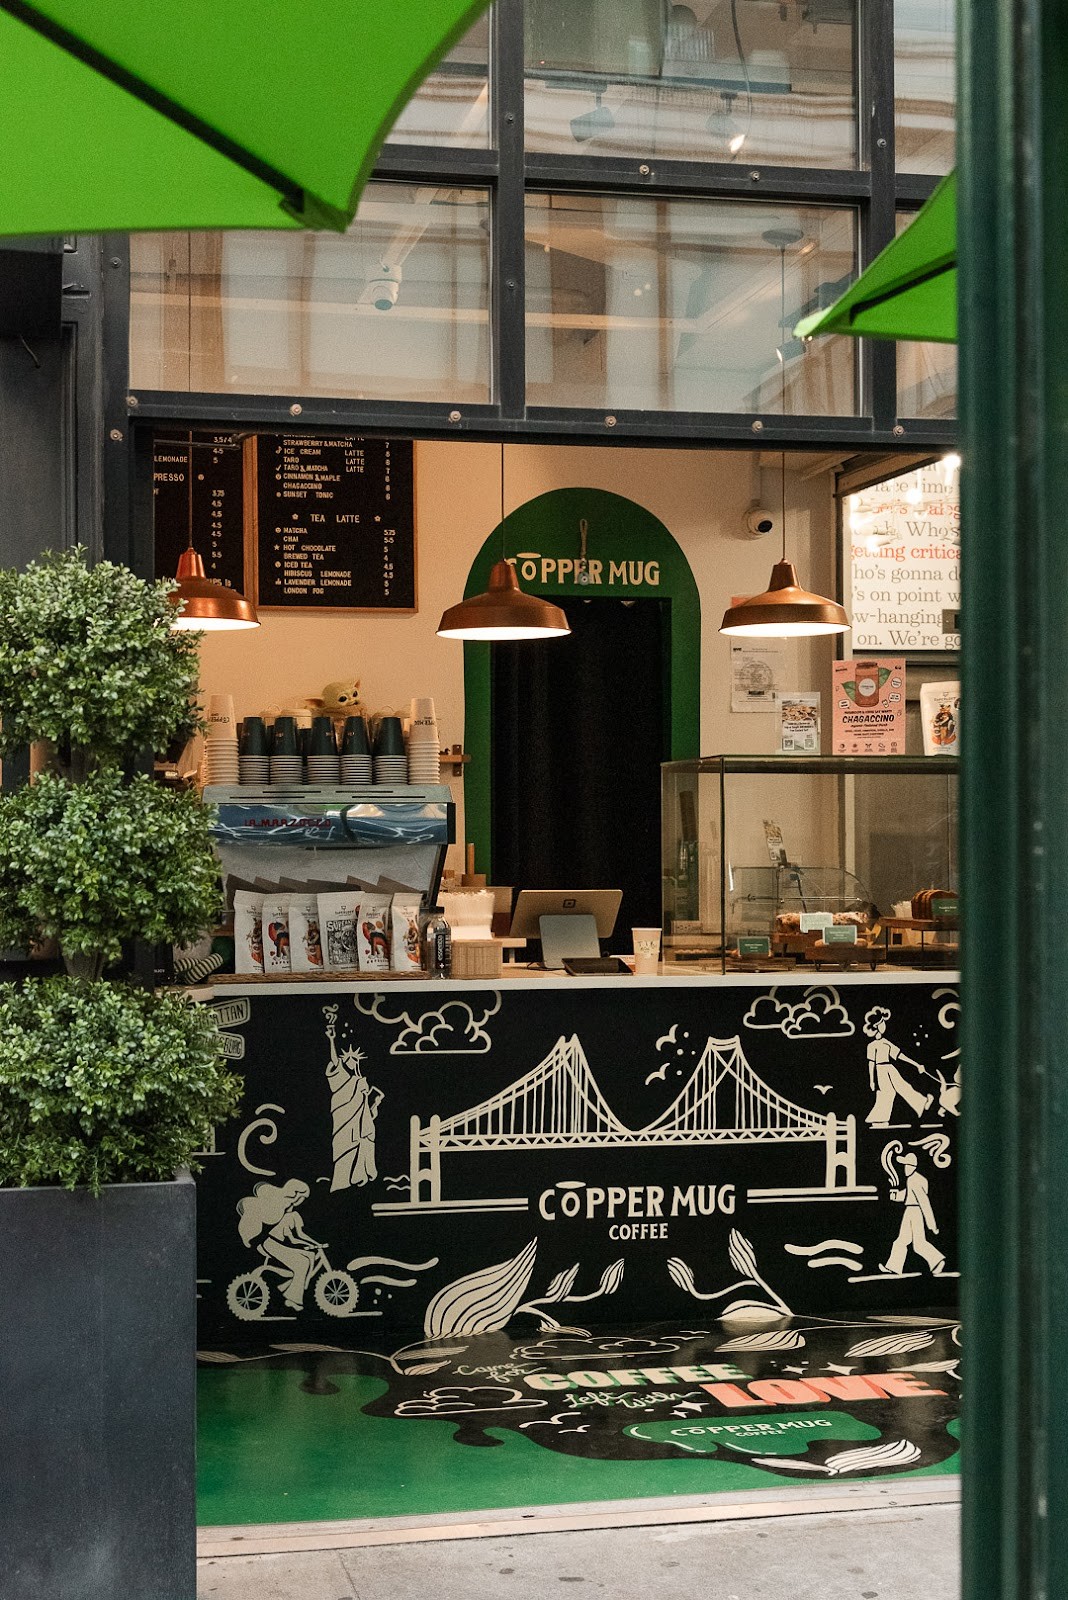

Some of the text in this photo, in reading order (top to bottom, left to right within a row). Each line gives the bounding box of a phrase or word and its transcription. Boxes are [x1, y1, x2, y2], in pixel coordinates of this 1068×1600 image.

[310, 514, 360, 523] TEA LATTE
[609, 560, 660, 586] MUG
[891, 568, 944, 583] gonna
[870, 591, 891, 601] on
[897, 588, 941, 605] point
[857, 635, 882, 646] on.
[889, 630, 940, 646] We're
[842, 714, 894, 724] CHAGACCINO
[539, 1181, 736, 1221] COPPER MUG
[608, 1223, 669, 1240] COFFEE
[452, 1362, 537, 1375] Came
[523, 1362, 753, 1391] COFFEE
[698, 1372, 949, 1408] LOVE
[670, 1419, 832, 1436] COPPER MUG
[735, 1429, 786, 1437] COFFEE
